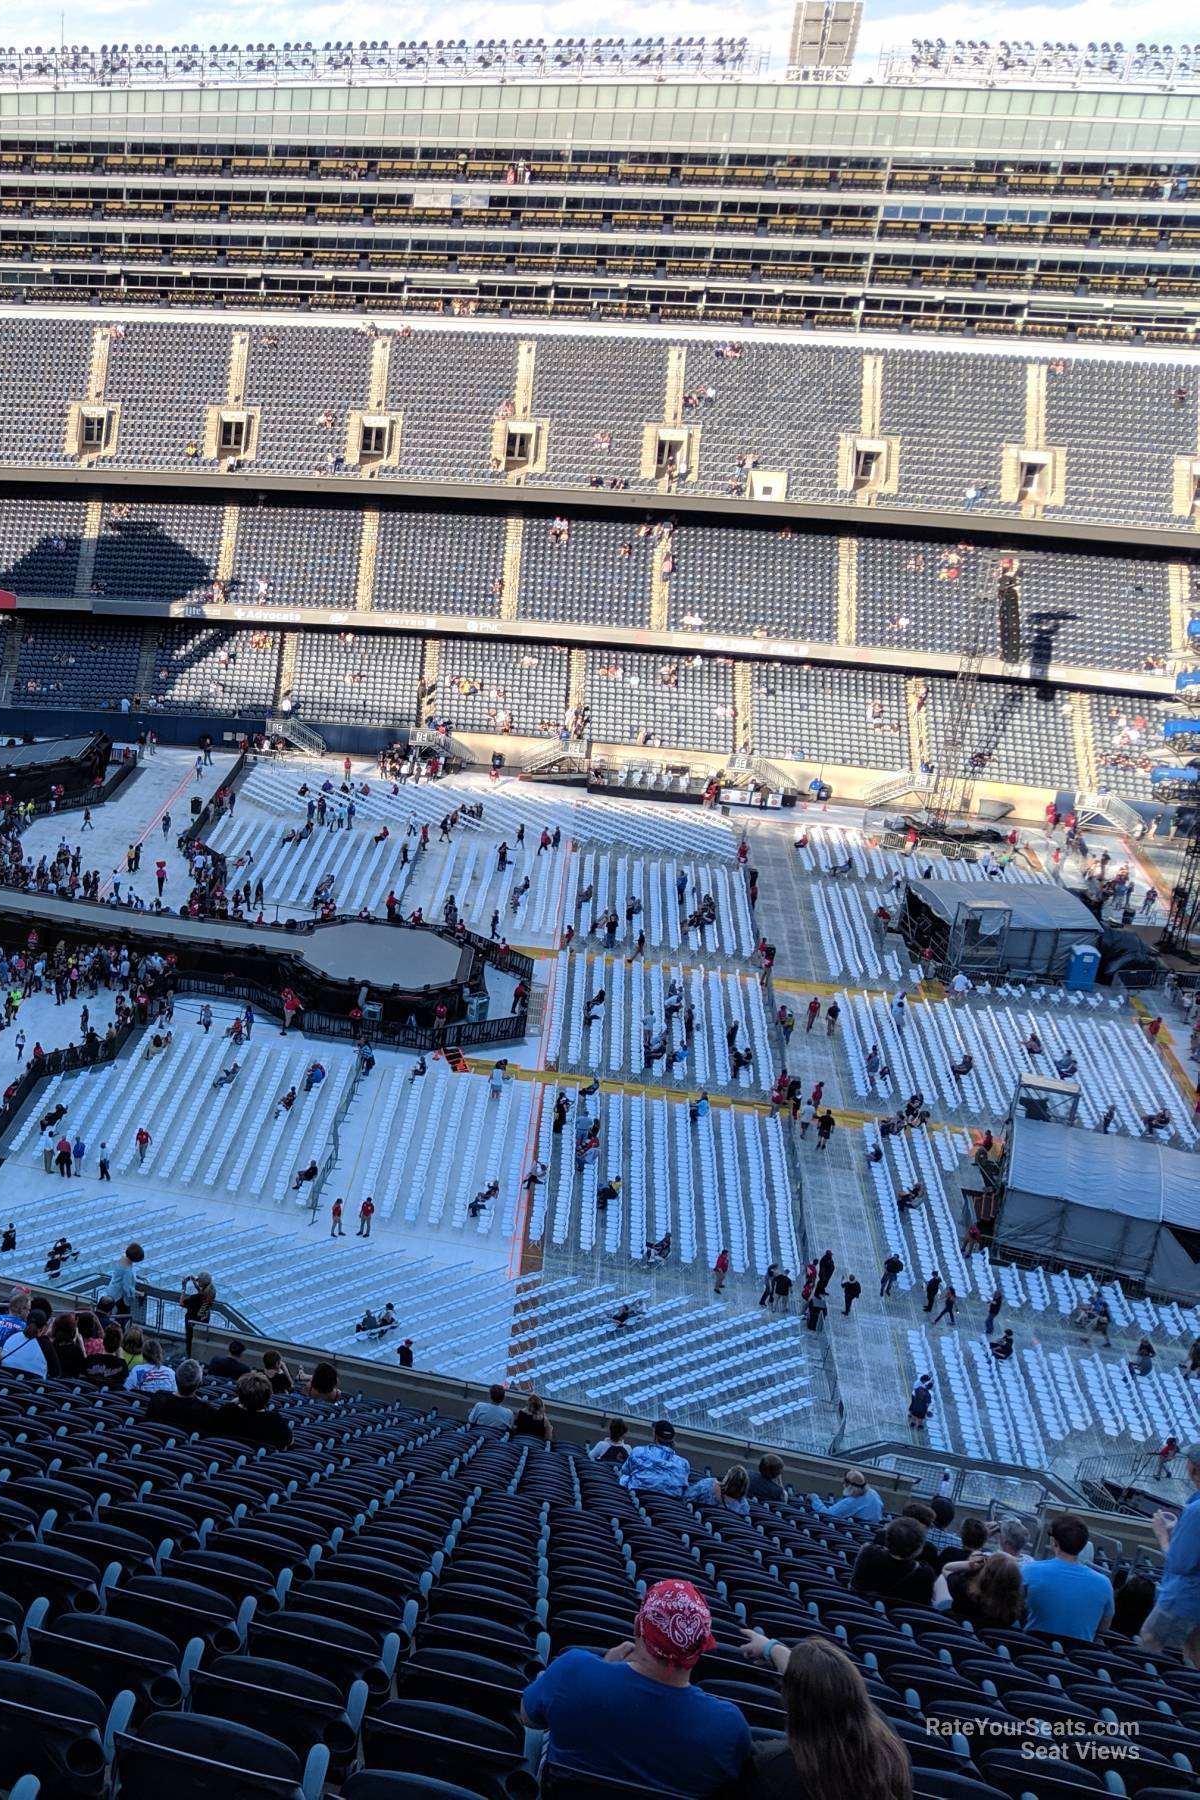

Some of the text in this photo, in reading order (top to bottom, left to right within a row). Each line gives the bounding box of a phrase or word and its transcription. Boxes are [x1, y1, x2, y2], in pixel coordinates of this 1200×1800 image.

[246, 610, 301, 621] Advocate
[384, 617, 425, 627] UNITED
[479, 622, 502, 632] PNC
